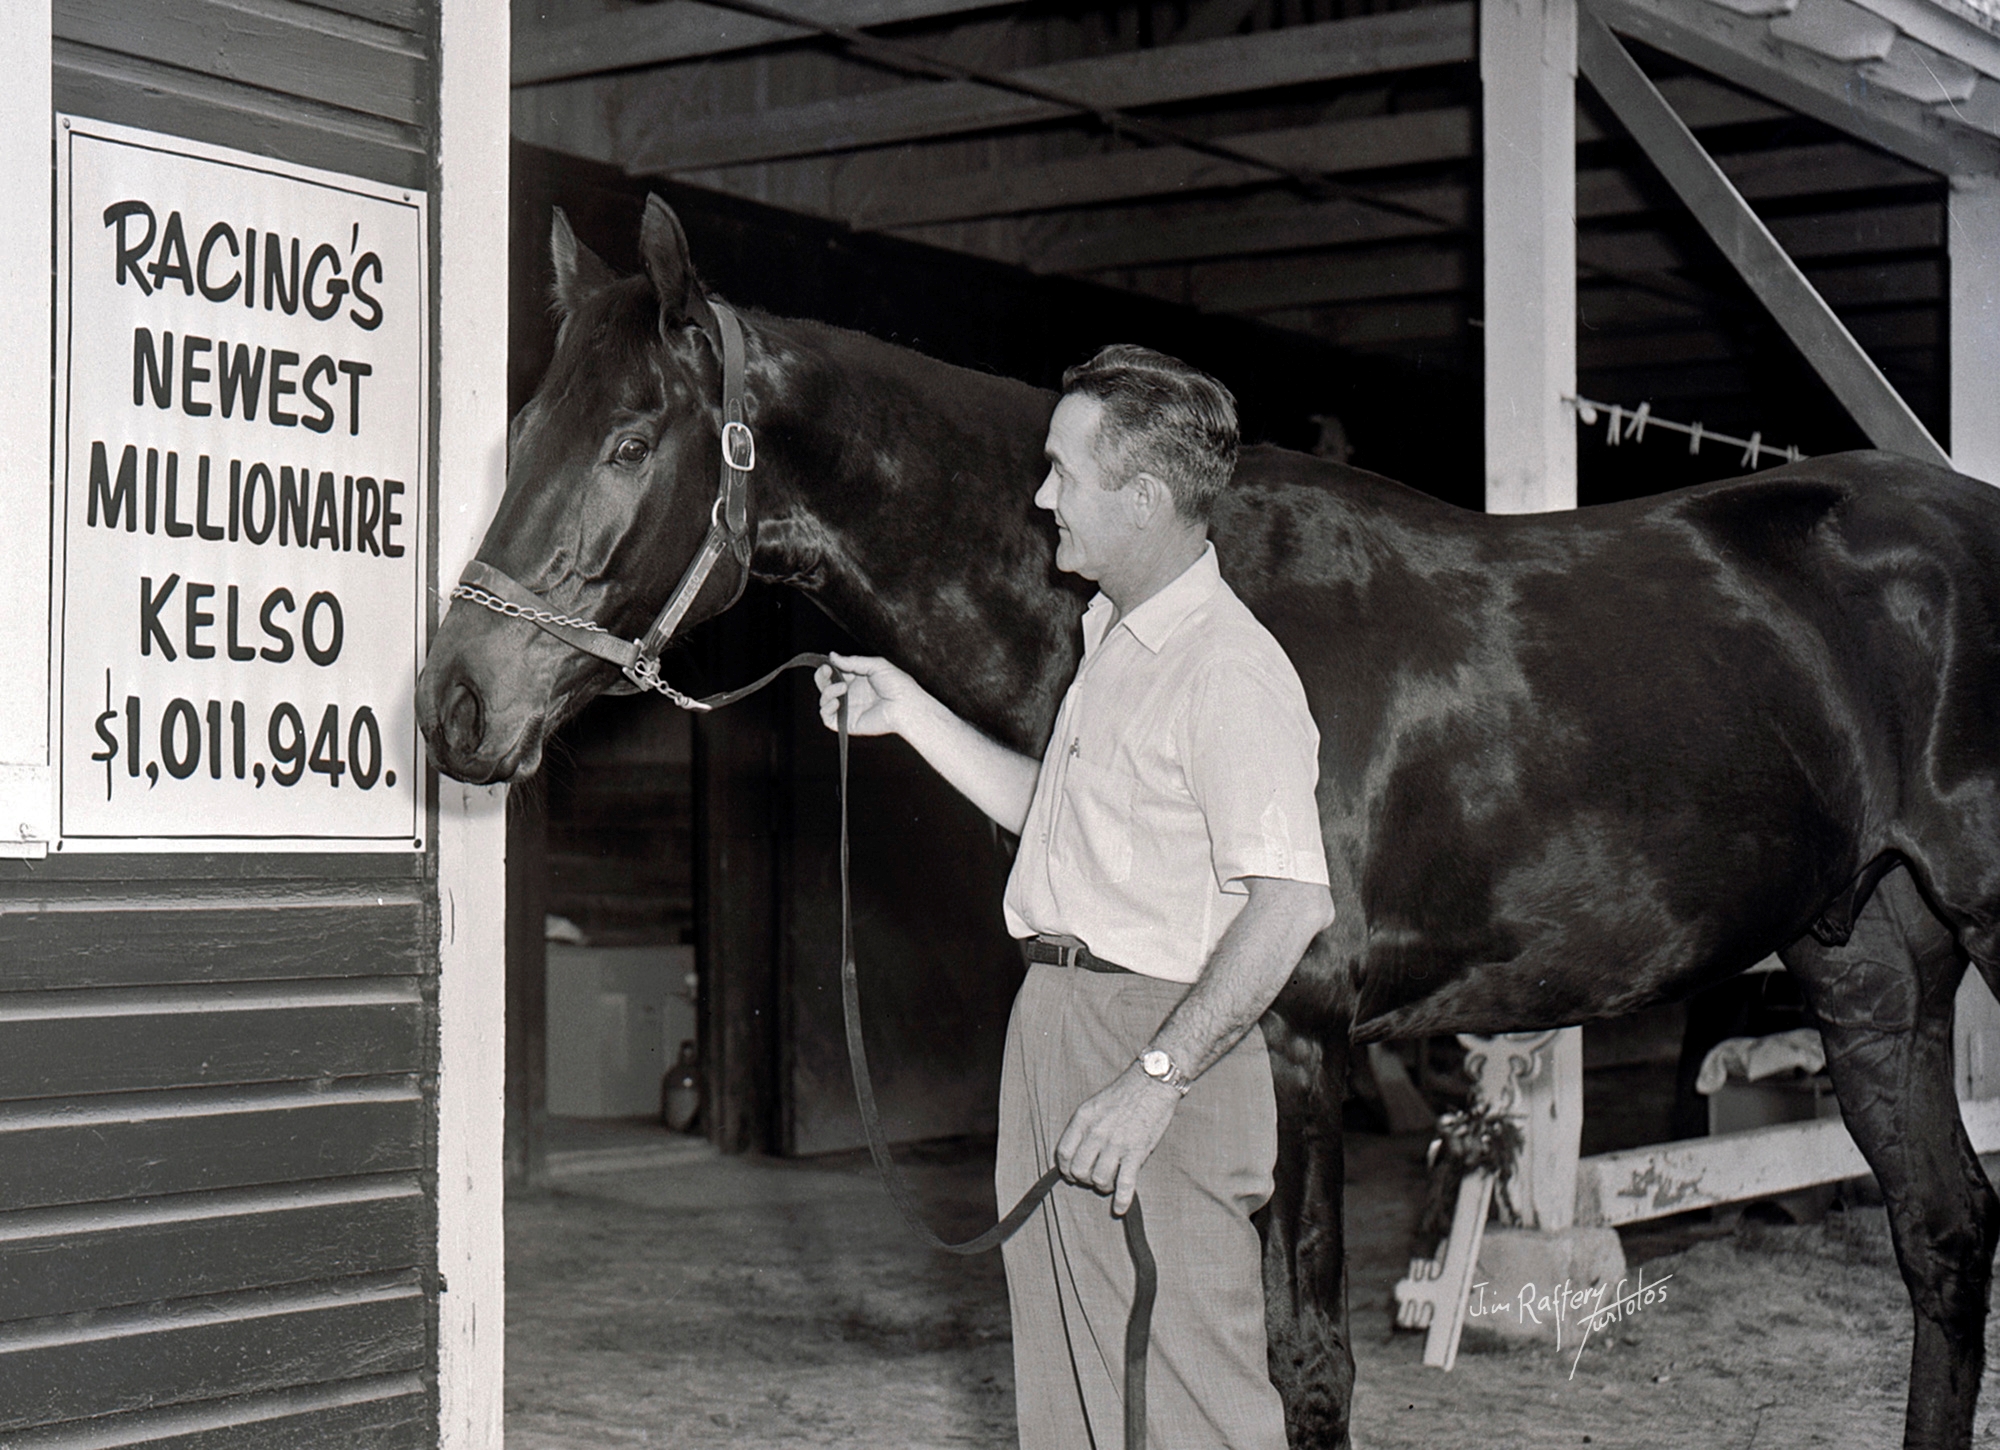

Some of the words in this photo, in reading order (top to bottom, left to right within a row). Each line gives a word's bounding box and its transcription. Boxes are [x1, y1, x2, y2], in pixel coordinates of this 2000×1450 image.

[103, 200, 384, 331] RACING'S
[133, 327, 373, 436] NEWEST
[88, 441, 406, 559] MILLIONAIRE
[140, 573, 344, 667] KELSO
[91, 667, 397, 801] $1,011,940.
